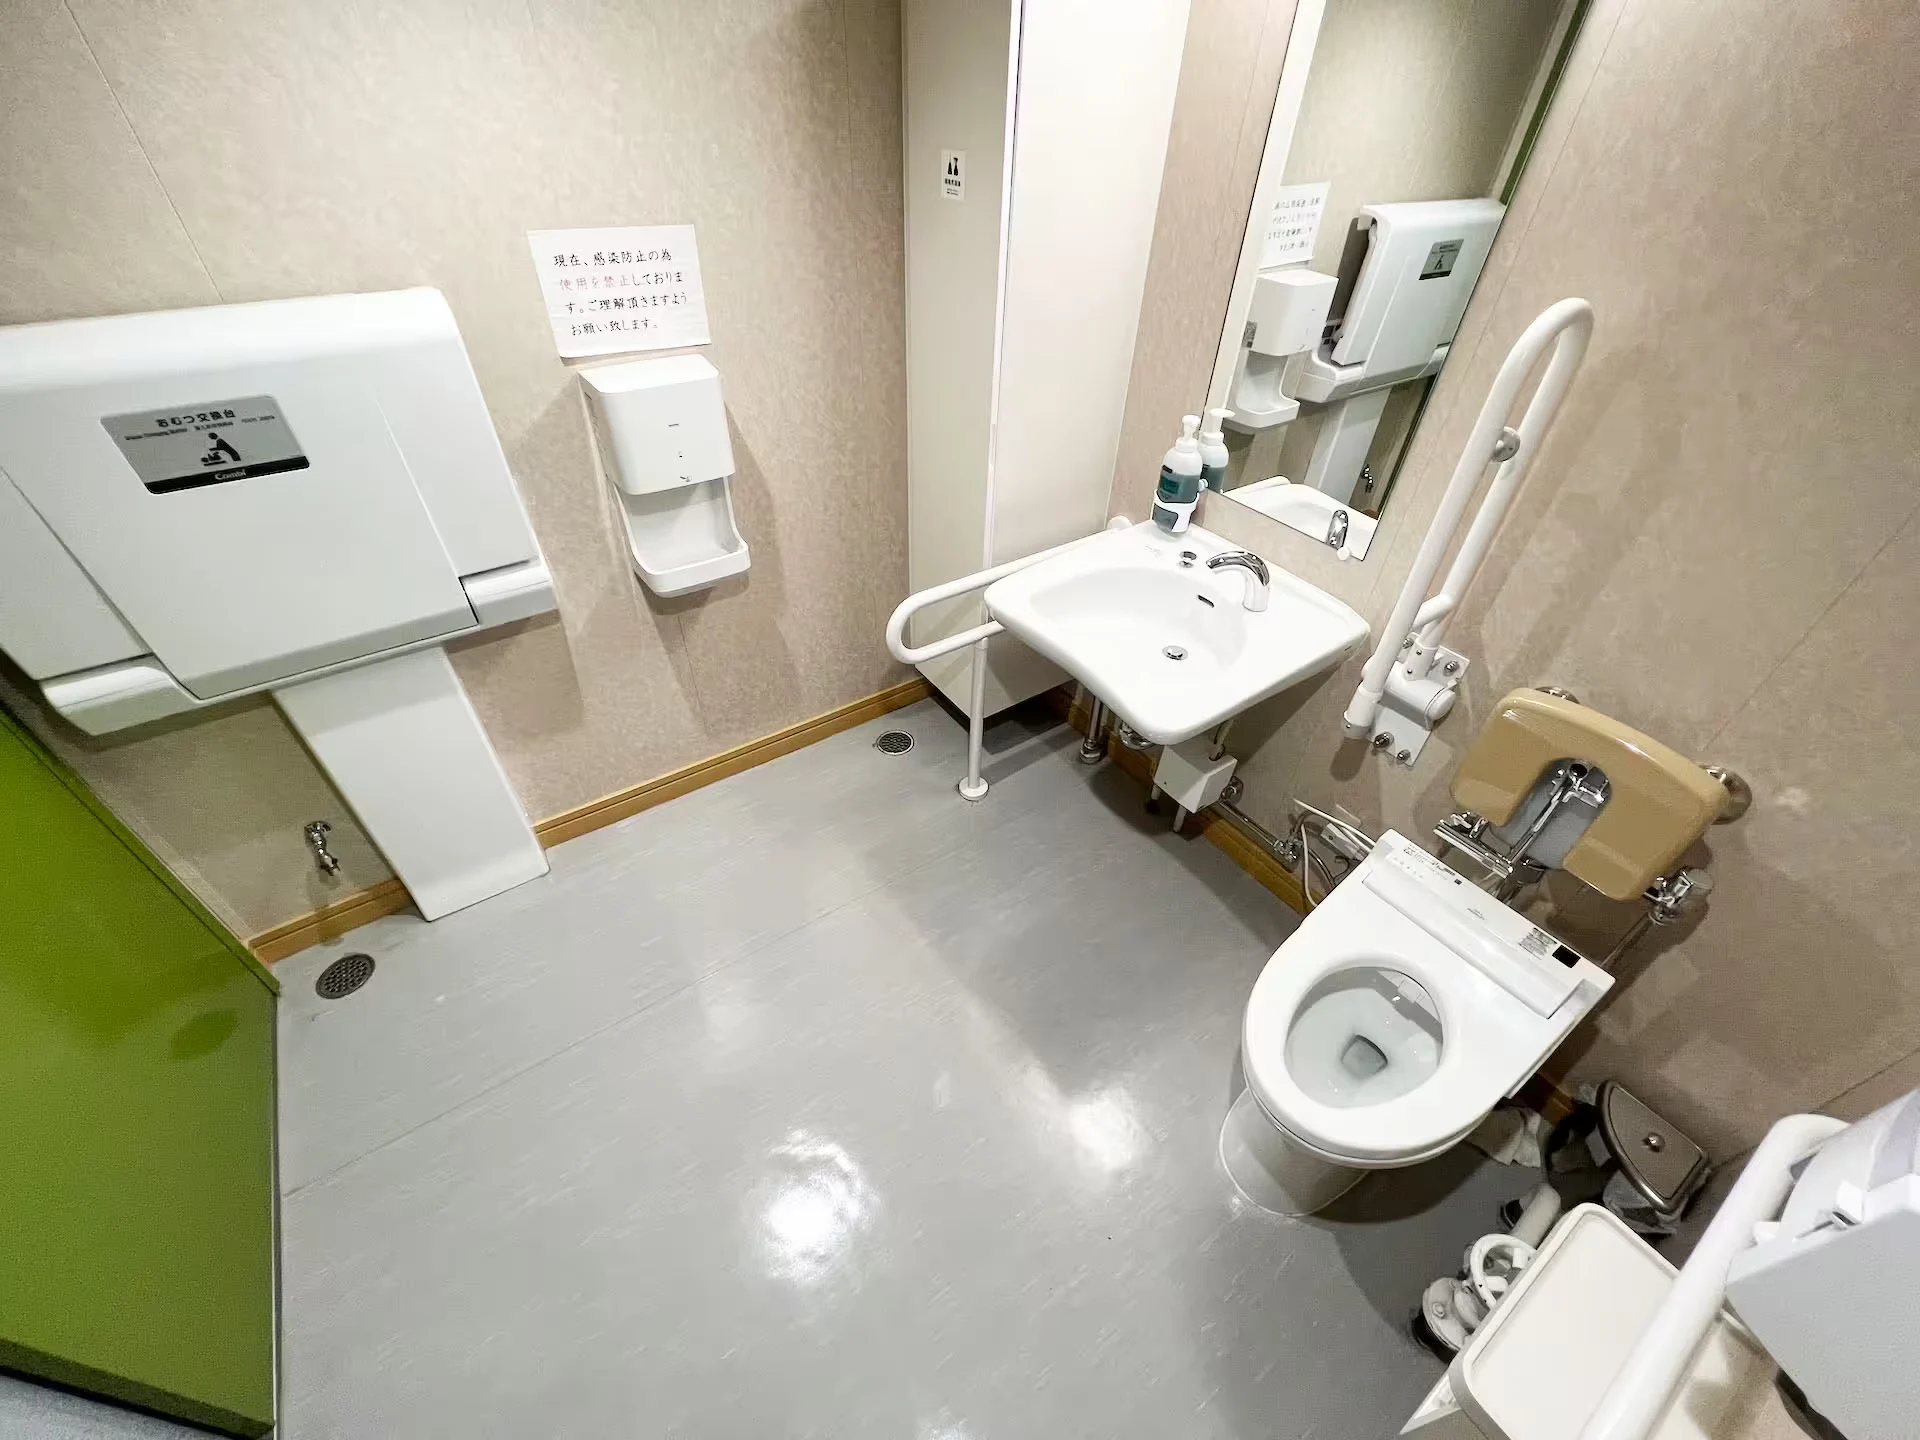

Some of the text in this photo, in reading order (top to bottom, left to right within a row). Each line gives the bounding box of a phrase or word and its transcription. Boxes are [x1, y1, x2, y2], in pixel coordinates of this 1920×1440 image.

[554, 248, 672, 267] 現在、感染防止の為
[560, 271, 683, 291] 使用を禁止しておりま
[565, 291, 687, 314] す。ご理解頂きますよう
[571, 317, 658, 336] お願い致します。
[156, 409, 236, 428] おむつ交換台
[214, 468, 247, 480] Combi
